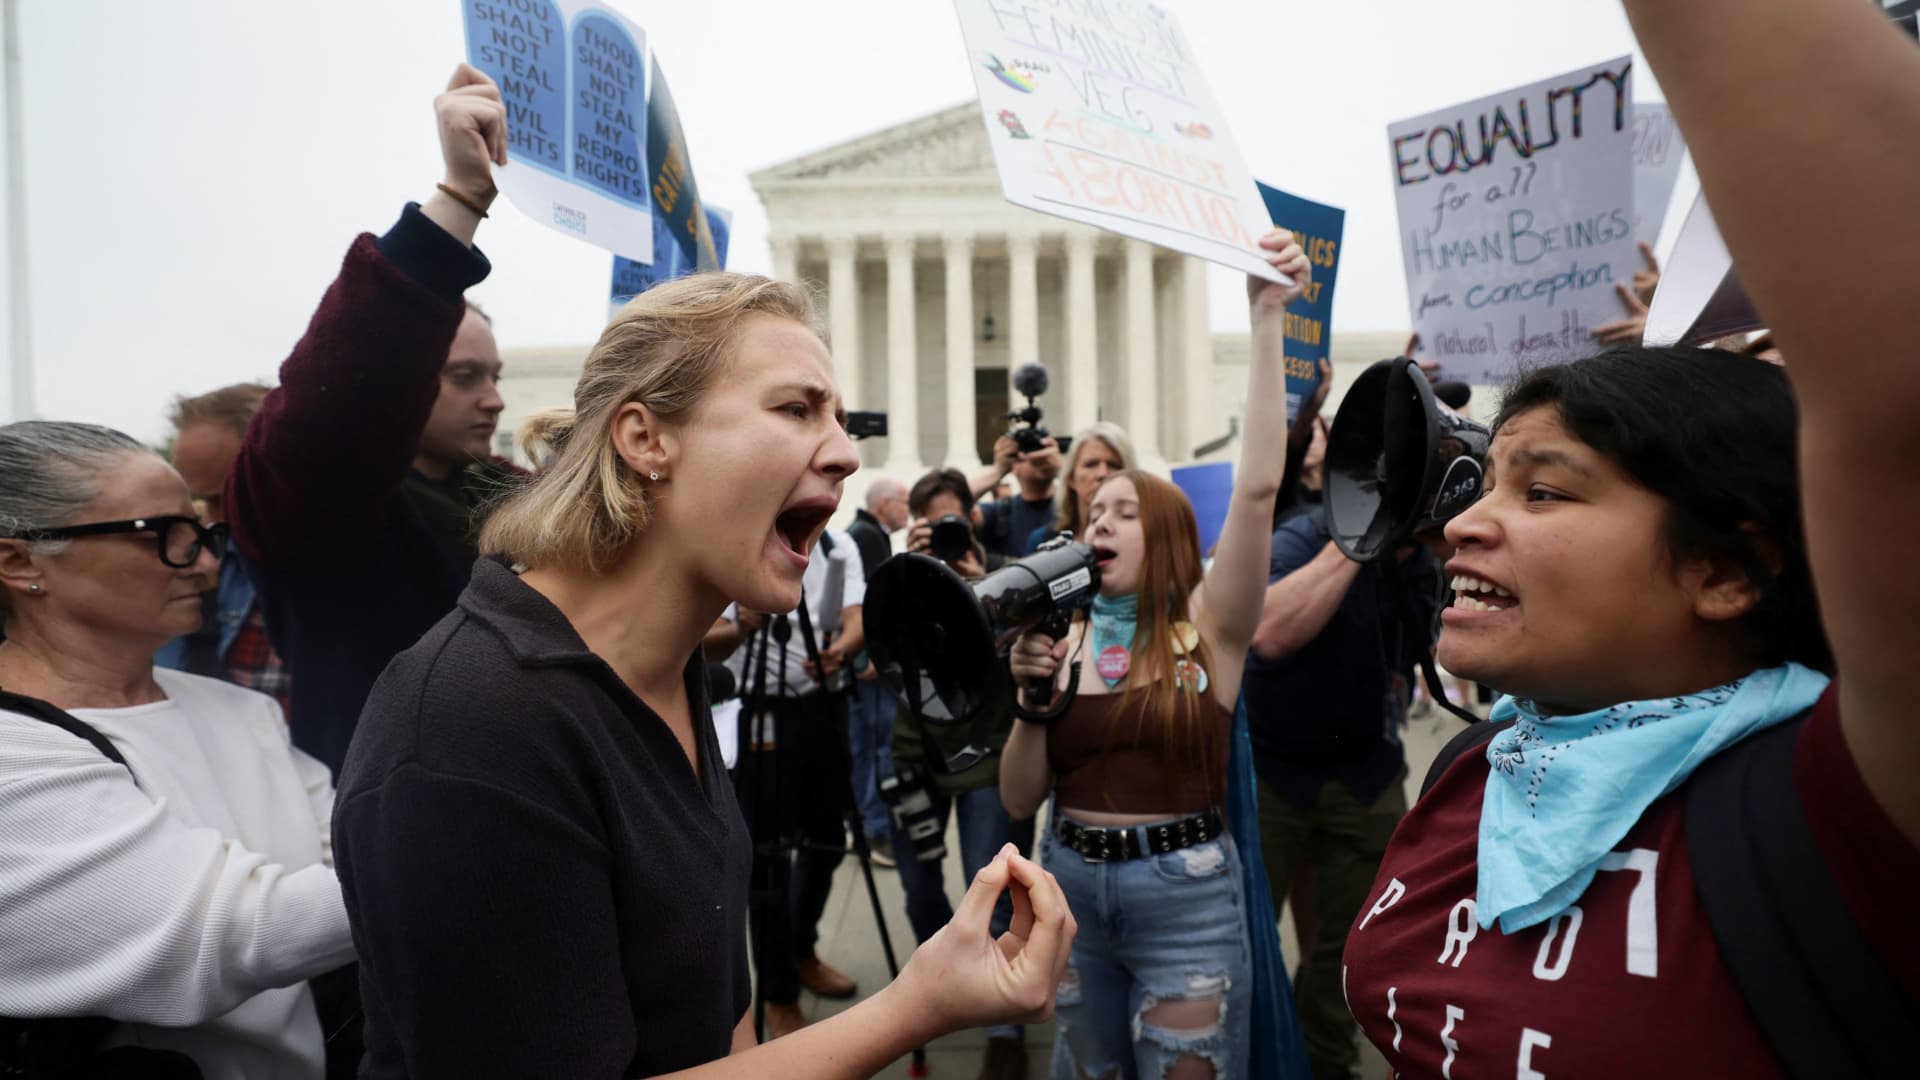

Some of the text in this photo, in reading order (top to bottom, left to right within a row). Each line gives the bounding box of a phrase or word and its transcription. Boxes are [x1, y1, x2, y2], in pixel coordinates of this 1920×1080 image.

[474, 2, 553, 46] SHALT
[491, 27, 541, 61] NOT
[481, 45, 554, 92] STEAL
[579, 45, 635, 90] SHALT
[583, 25, 634, 69] THOU
[503, 74, 535, 103] MY
[590, 72, 627, 106] NOT
[1055, 60, 1153, 133] VEG
[505, 100, 548, 135] IVIL
[580, 90, 637, 133] STEAL
[595, 119, 623, 145] MY
[1394, 61, 1633, 185] EQUALITY
[578, 132, 639, 173] REPRO
[1044, 110, 1229, 190] AGAINST
[575, 153, 642, 197] RIGHTS
[1431, 161, 1537, 235] for all
[1507, 207, 1630, 266] BEINGS
[1465, 261, 1614, 309] conception
